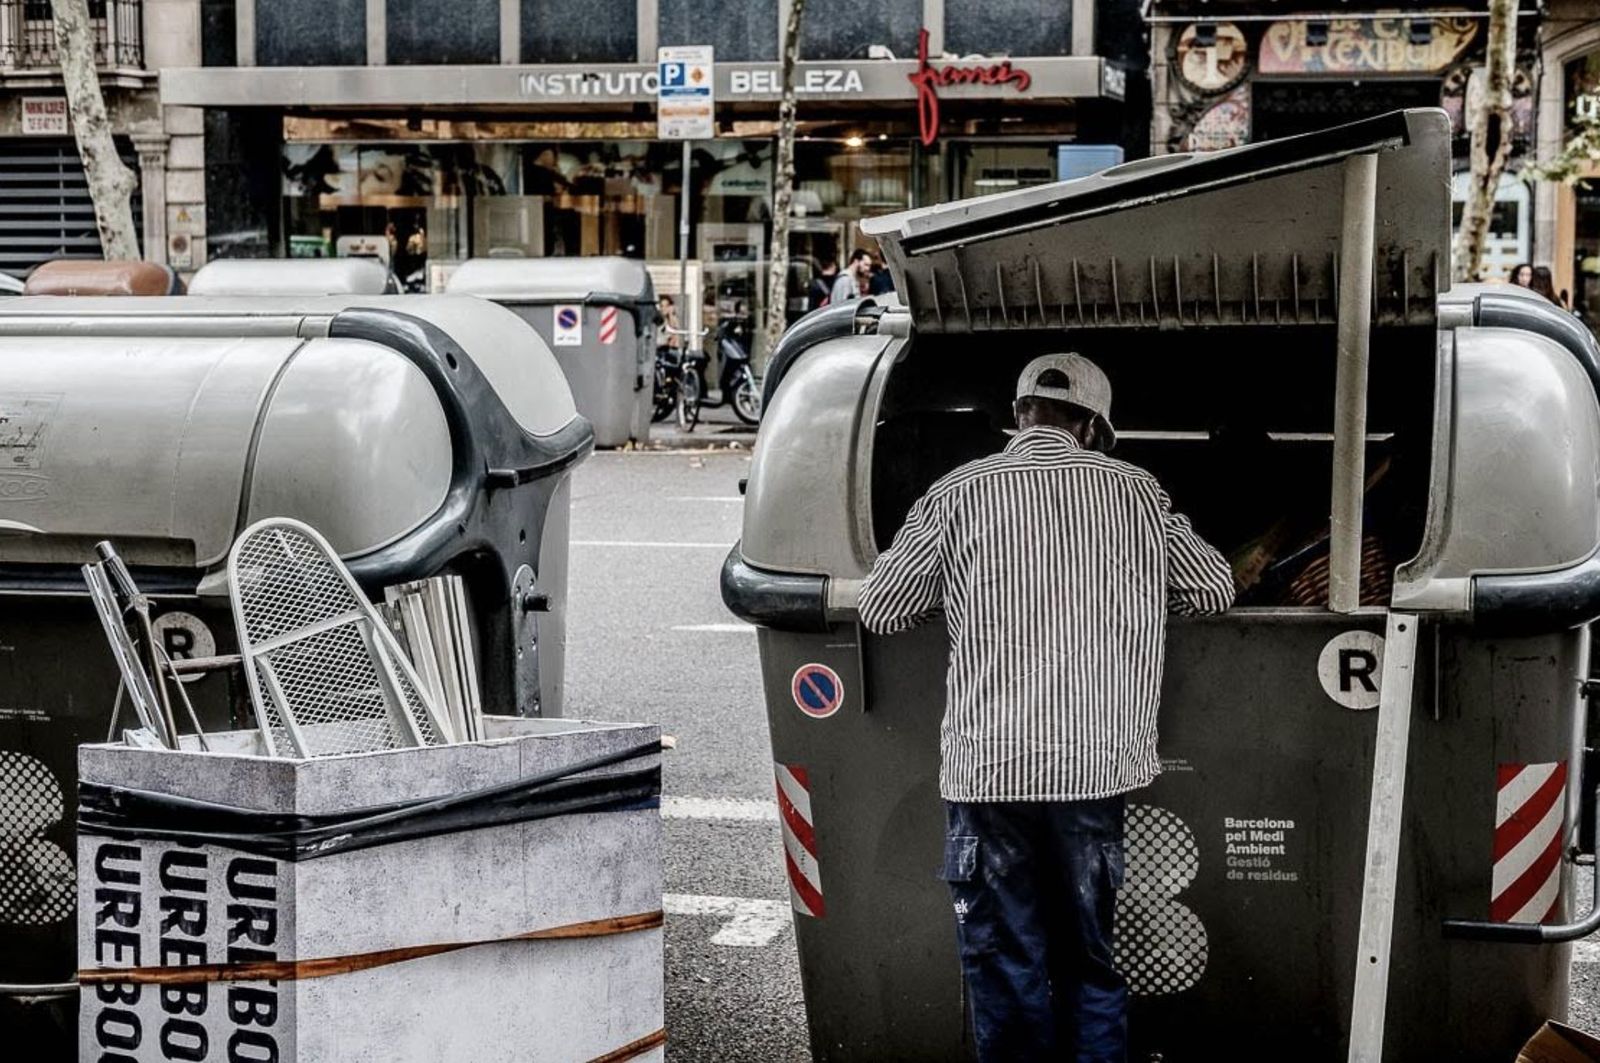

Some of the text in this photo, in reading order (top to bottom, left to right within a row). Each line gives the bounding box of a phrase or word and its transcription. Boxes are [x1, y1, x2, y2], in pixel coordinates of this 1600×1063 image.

[665, 64, 681, 86] P
[163, 627, 196, 661] R
[1338, 648, 1378, 692] R
[1224, 817, 1294, 828] Barcelona
[1225, 830, 1284, 843] pel Medi
[1226, 843, 1285, 854] Ambient
[1226, 855, 1271, 868] Gestió
[1226, 869, 1298, 881] de residus
[158, 844, 210, 1062] UREBO
